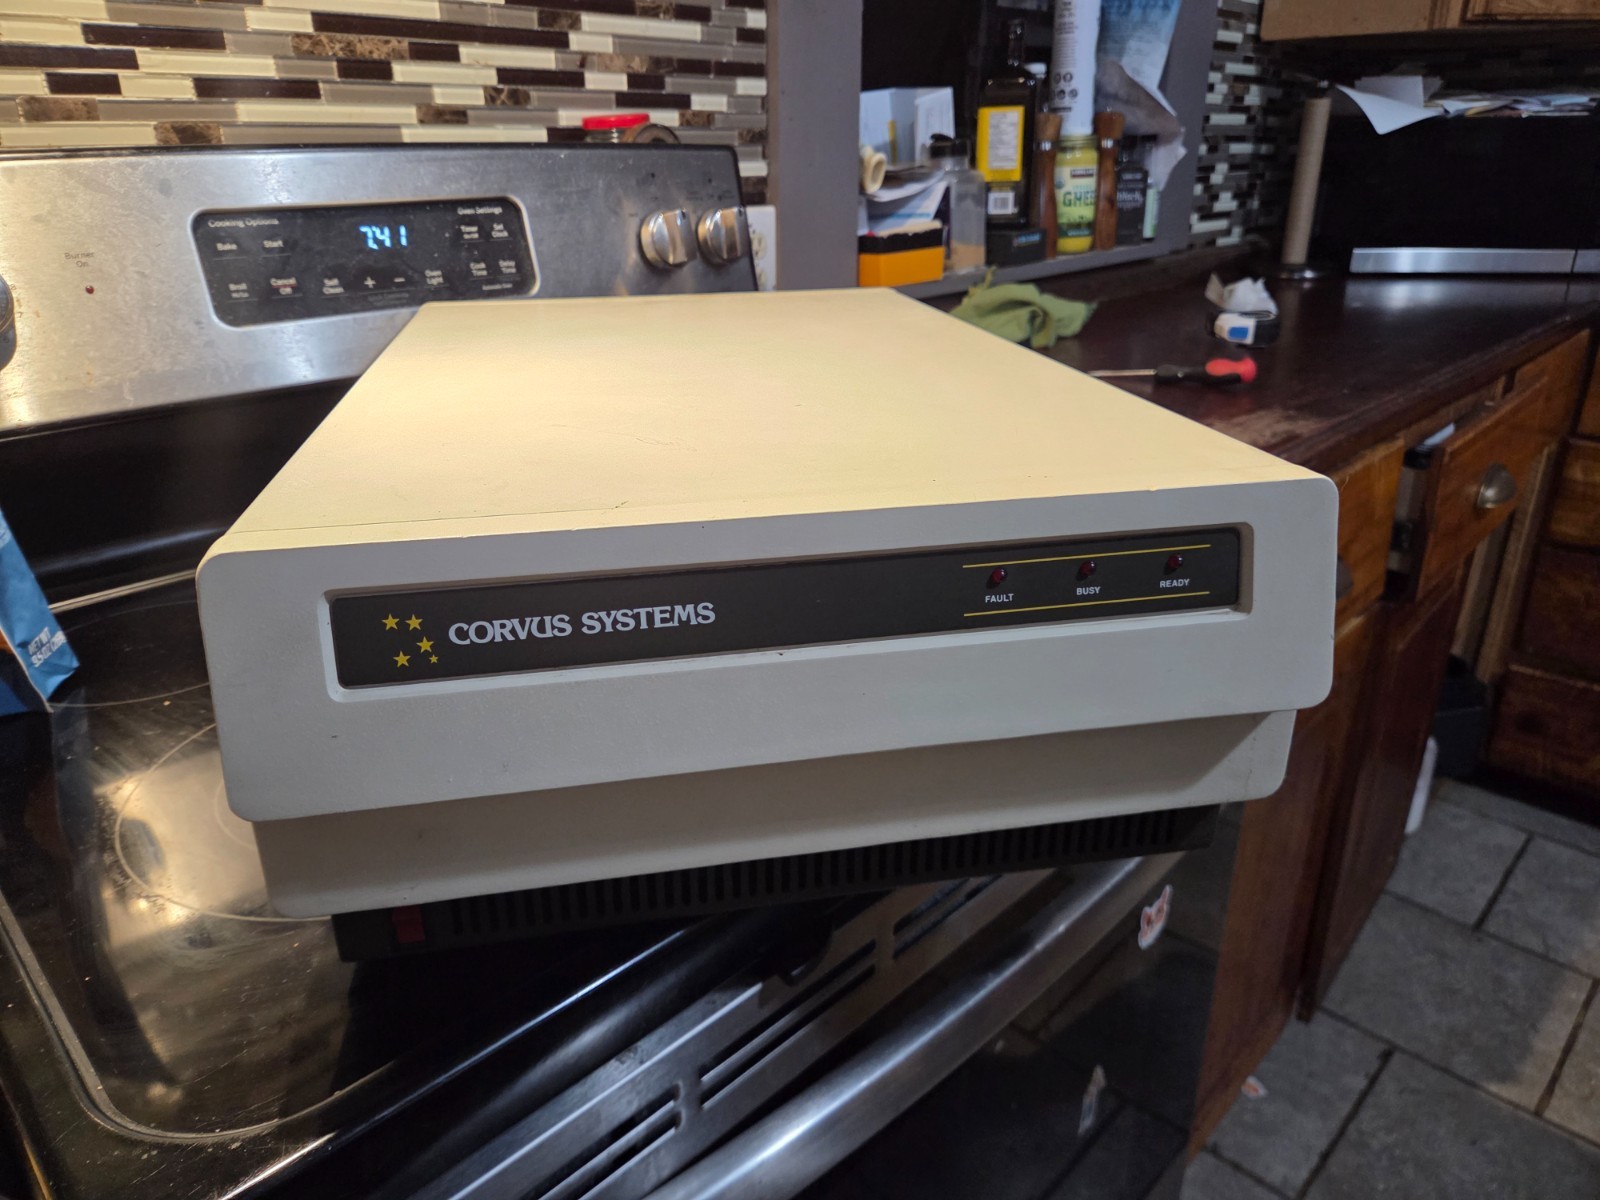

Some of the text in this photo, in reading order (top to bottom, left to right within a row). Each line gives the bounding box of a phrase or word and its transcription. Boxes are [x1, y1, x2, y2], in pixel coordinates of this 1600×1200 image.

[475, 206, 503, 215] Settings
[208, 218, 280, 229] Cooking Options
[216, 242, 238, 251] Bake
[263, 240, 284, 248] Start
[64, 252, 95, 260] Burner
[270, 277, 297, 287] Cancel
[1159, 578, 1190, 589] READY
[1076, 586, 1101, 596] BUSY
[985, 593, 1014, 604] FAULT
[448, 602, 716, 646] CORVUS SYSTEMS
